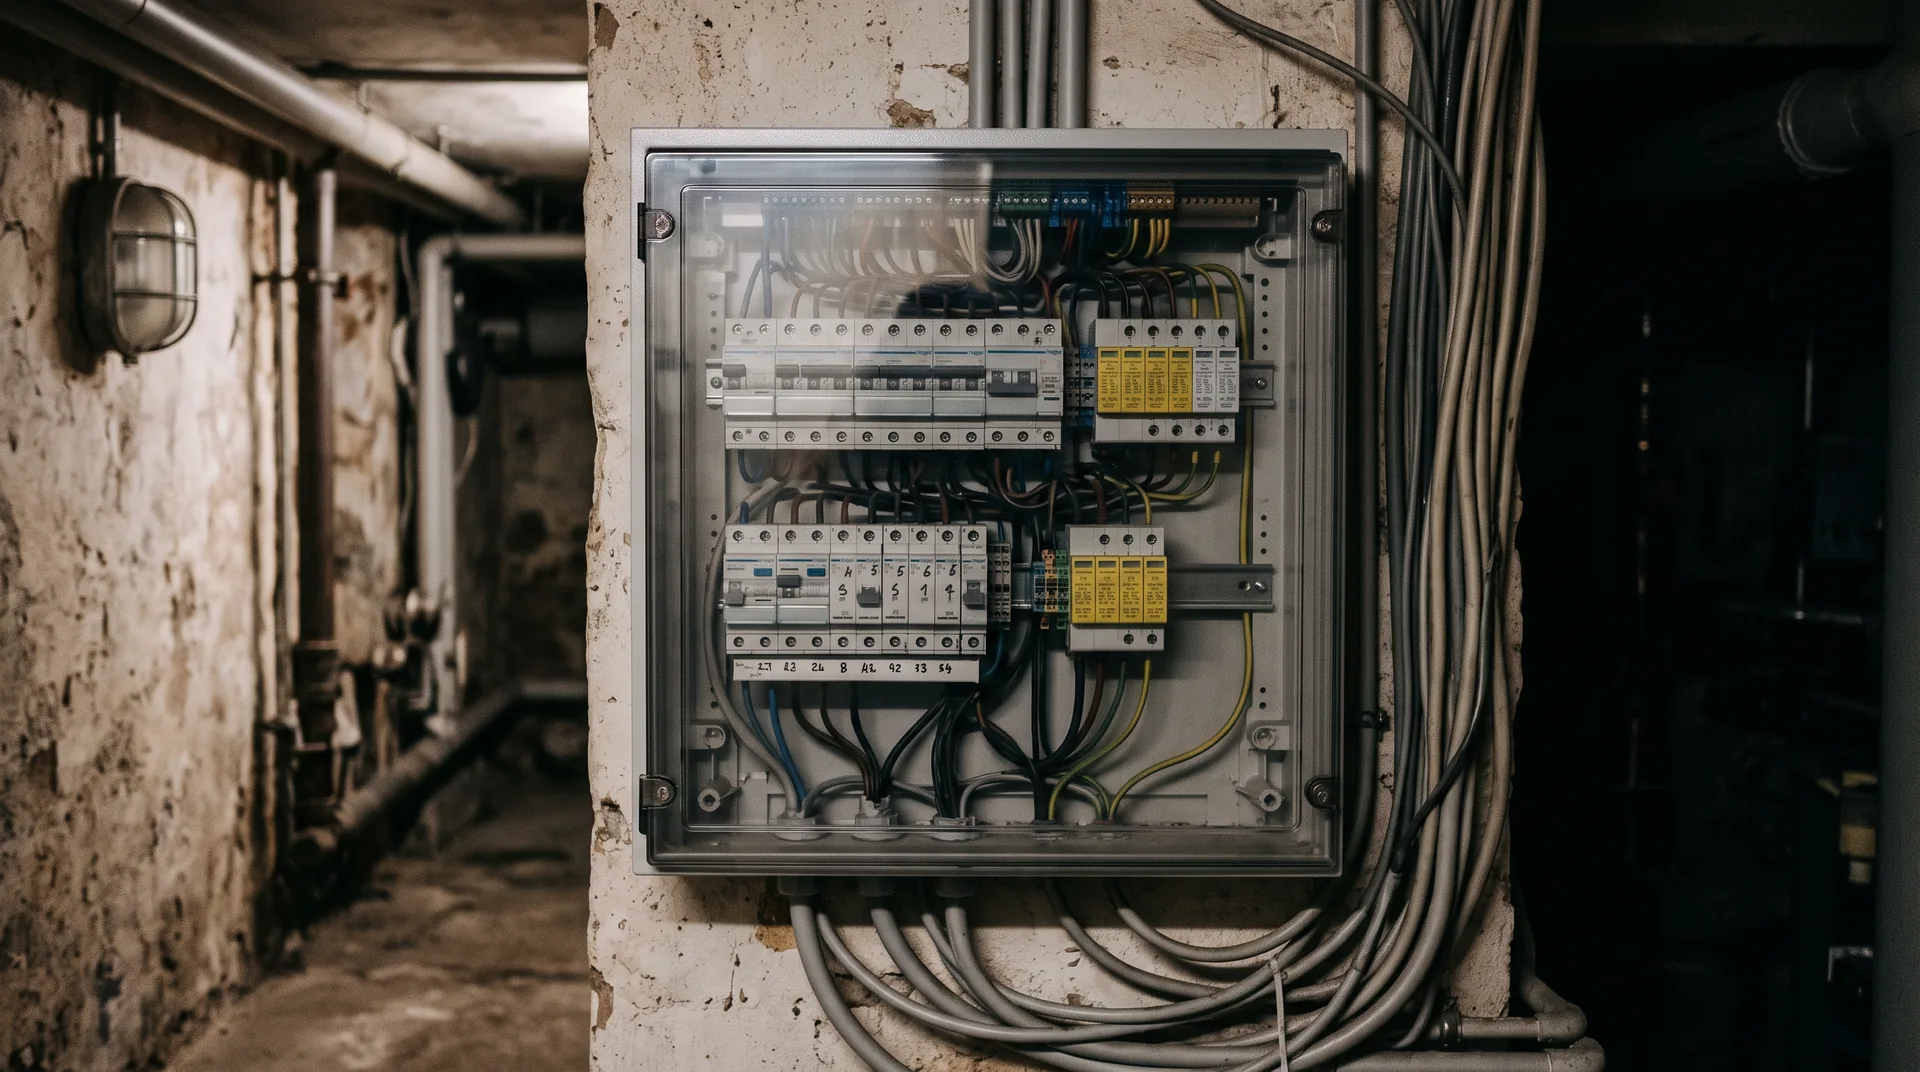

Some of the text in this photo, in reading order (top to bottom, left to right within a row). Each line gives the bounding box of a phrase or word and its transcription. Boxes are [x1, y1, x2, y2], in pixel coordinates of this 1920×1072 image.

[897, 565, 906, 577] 5
[923, 565, 931, 578] 6
[811, 662, 825, 672] 24
[840, 661, 848, 674] 8
[888, 662, 902, 673] 92
